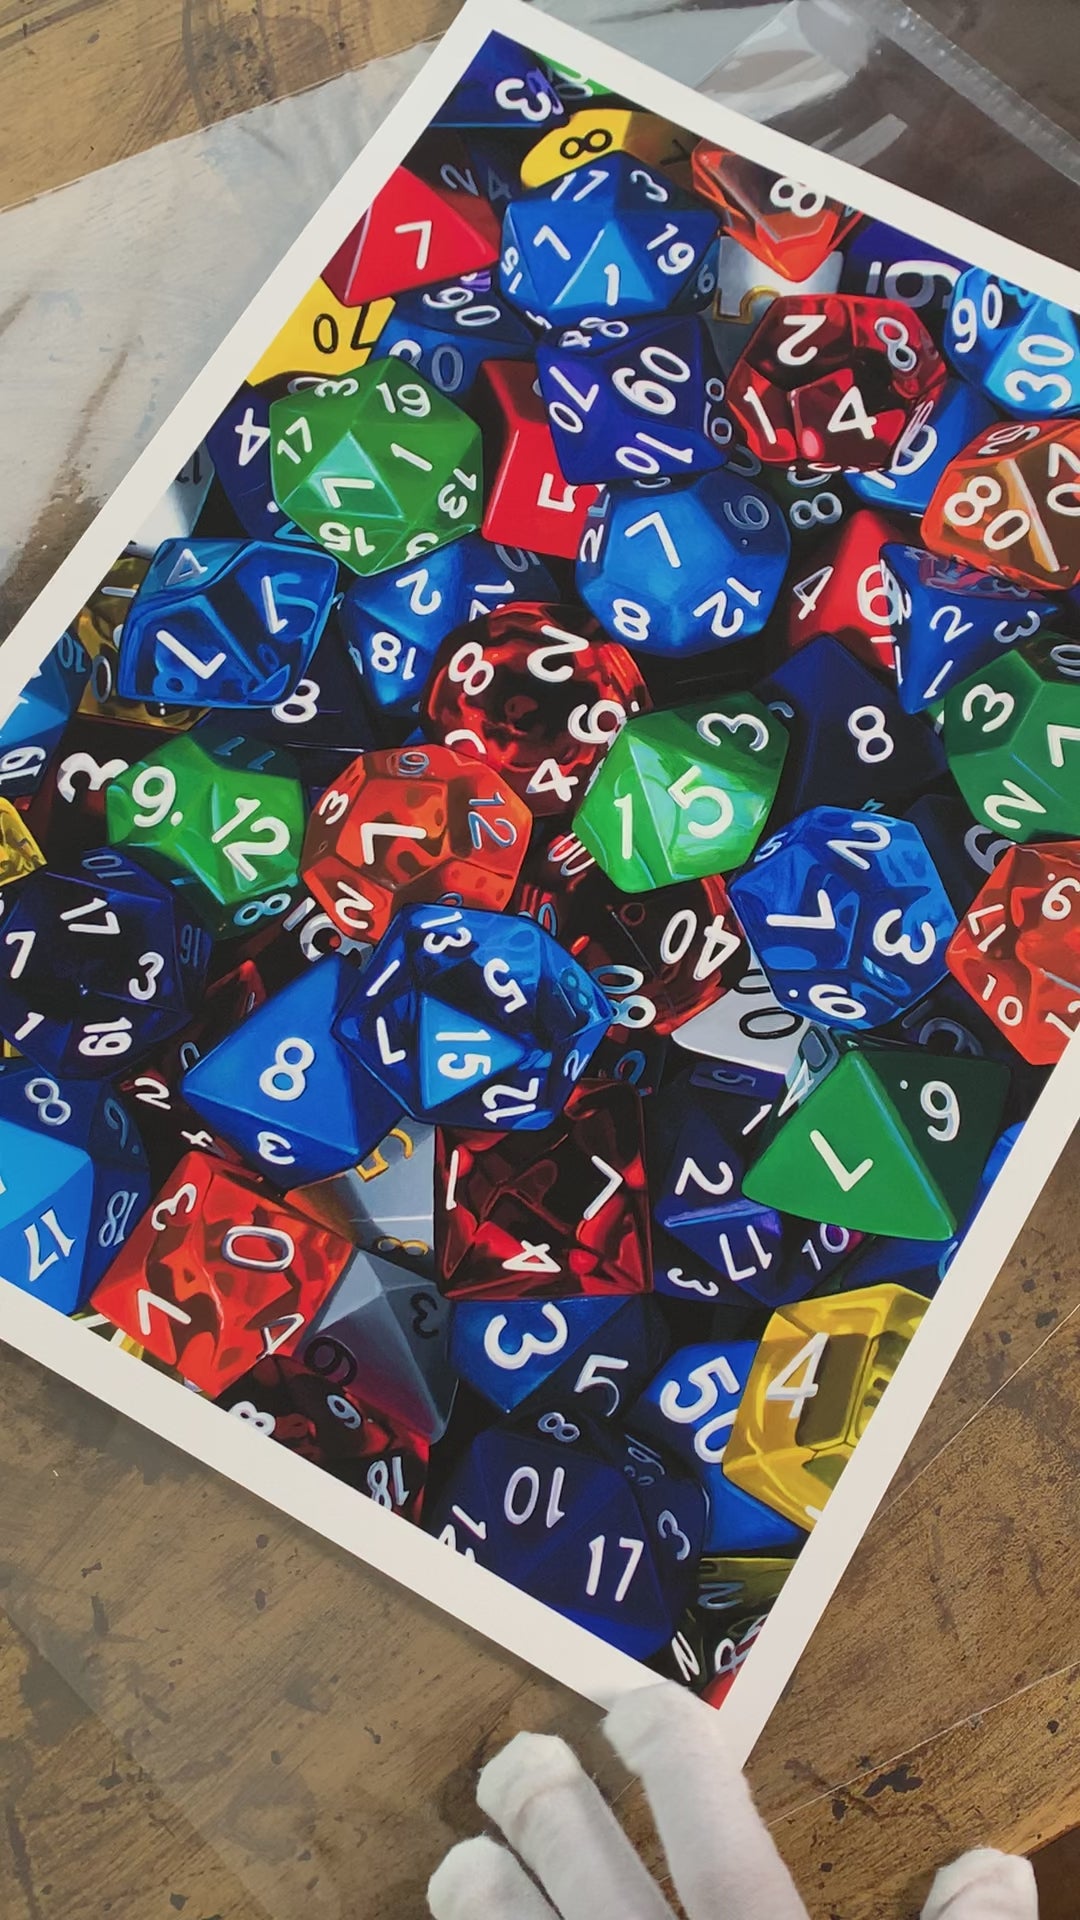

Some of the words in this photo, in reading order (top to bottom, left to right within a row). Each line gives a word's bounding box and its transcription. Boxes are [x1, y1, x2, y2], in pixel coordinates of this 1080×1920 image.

[495, 78, 551, 121] 3
[560, 129, 612, 159] 8
[441, 164, 479, 196] 2
[552, 170, 609, 202] 17
[630, 170, 668, 202] 3
[770, 177, 826, 218] 8
[395, 220, 432, 270] 7
[533, 225, 571, 260] 7
[646, 223, 695, 275] 19
[501, 247, 522, 293] 15
[604, 263, 620, 306] 1
[777, 314, 827, 366] 2
[952, 284, 1003, 353] 90
[874, 317, 917, 371] 8
[314, 377, 359, 398] 3
[1004, 334, 1074, 410] 30
[376, 382, 431, 417] 19
[549, 366, 599, 433] 70
[743, 385, 777, 445] 1
[826, 386, 877, 440] 4
[234, 408, 271, 466] 4
[277, 416, 312, 464] 17
[390, 443, 433, 472] 1
[615, 432, 693, 475] 10
[321, 477, 375, 509] 7
[437, 468, 478, 519] 13
[790, 492, 842, 529] 8
[944, 476, 1030, 550] 80
[318, 521, 375, 557] 15
[625, 511, 682, 568] 7
[395, 568, 442, 615] 2
[693, 577, 762, 638] 12
[793, 566, 834, 620] 4
[613, 598, 651, 641] 8
[930, 605, 973, 643] 2
[994, 611, 1041, 643] 3
[156, 629, 227, 680] 7
[371, 631, 416, 680] 18
[448, 642, 494, 696] 8
[526, 625, 589, 683] 2
[271, 678, 321, 724] 8
[923, 660, 953, 699] 1
[696, 712, 769, 752] 3
[962, 683, 1015, 733] 3
[847, 705, 894, 763] 8
[526, 759, 579, 802] 4
[983, 779, 1047, 829] 2
[319, 790, 349, 825] 3
[468, 792, 517, 849] 12
[211, 797, 290, 881] 12
[360, 823, 427, 865] 7
[827, 821, 891, 870] 2
[60, 898, 121, 935] 17
[234, 893, 291, 926] 8
[335, 881, 374, 929] 2
[766, 889, 836, 930] 7
[968, 903, 1006, 953] 17
[5, 931, 36, 979] 7
[420, 912, 472, 953] 13
[660, 909, 741, 981] 40
[873, 908, 936, 965] 3
[128, 951, 165, 1001] 3
[366, 960, 400, 997] 1
[484, 958, 527, 1013] 5
[982, 974, 1023, 1026] 10
[14, 1011, 45, 1041] 1
[78, 1016, 133, 1056] 19
[376, 1016, 406, 1065] 7
[259, 1037, 315, 1101] 8
[436, 1029, 492, 1079] 15
[564, 1049, 591, 1081] 2
[25, 1077, 72, 1126] 8
[134, 1077, 172, 1111] 2
[482, 1077, 539, 1124] 12
[257, 1131, 296, 1165] 3
[810, 1130, 874, 1192] 7
[446, 1149, 460, 1211] 1
[584, 1155, 624, 1221] 7
[674, 1157, 734, 1196] 2
[151, 1183, 198, 1231] 3
[24, 1208, 76, 1282] 17
[221, 1225, 295, 1272] 0
[502, 1240, 562, 1273] 4
[719, 1225, 773, 1281] 17
[802, 1223, 850, 1271] 10
[667, 1267, 719, 1297] 3
[136, 1288, 192, 1336] 7
[410, 1292, 439, 1339] 3
[484, 1302, 568, 1370] 3
[574, 1354, 629, 1418] 5
[766, 1332, 830, 1419] 4
[228, 1401, 276, 1437] 8
[537, 1412, 580, 1443] 8
[660, 1356, 741, 1464] 50
[504, 1466, 565, 1528] 10
[657, 1509, 690, 1561] 3
[585, 1535, 644, 1602] 17
